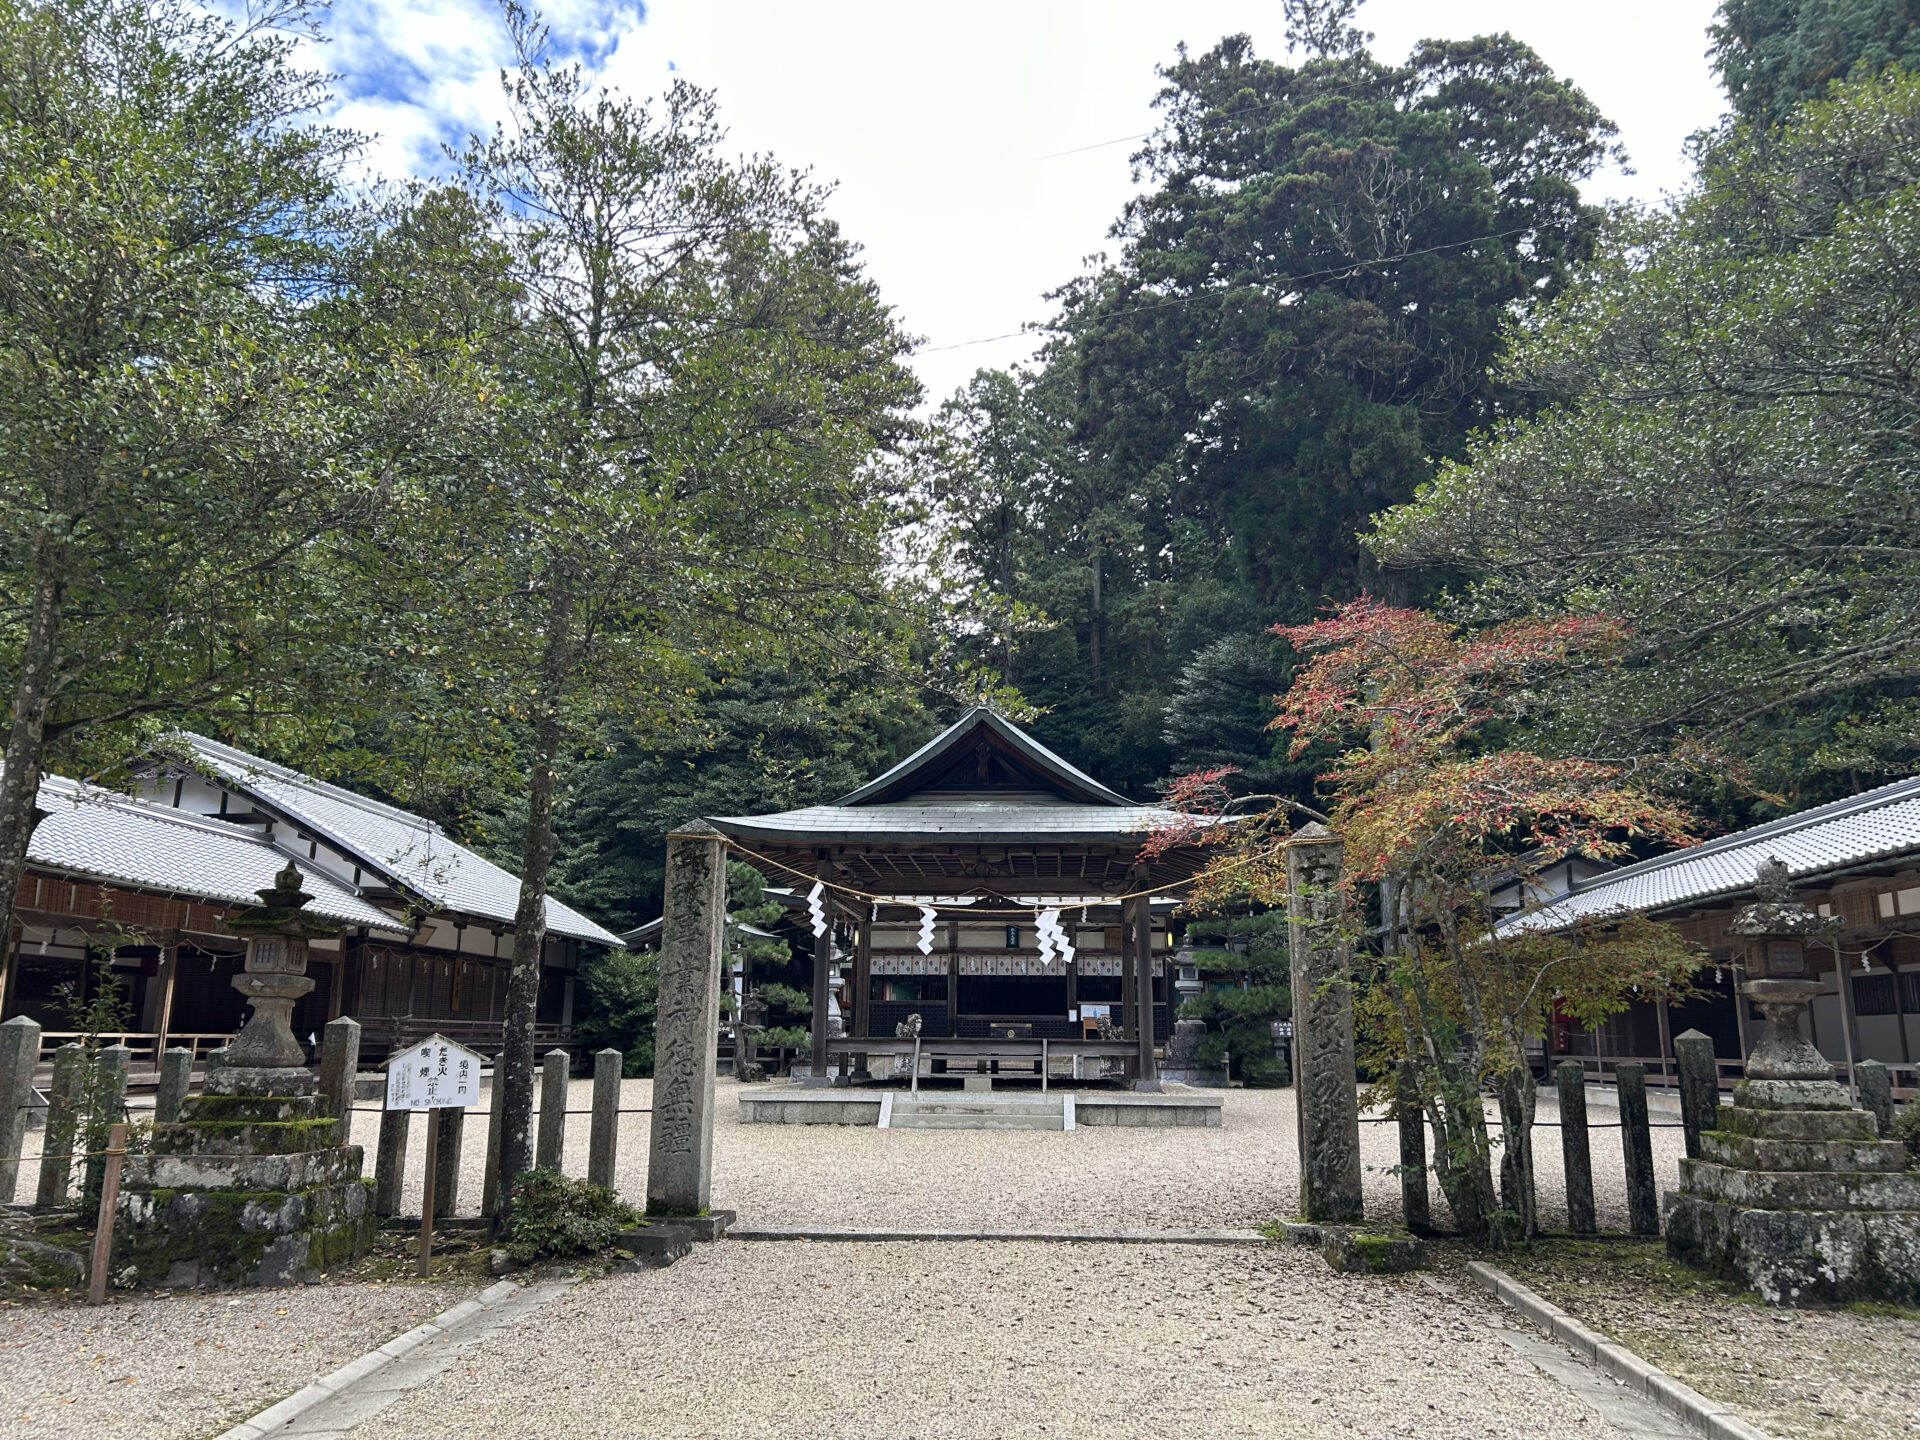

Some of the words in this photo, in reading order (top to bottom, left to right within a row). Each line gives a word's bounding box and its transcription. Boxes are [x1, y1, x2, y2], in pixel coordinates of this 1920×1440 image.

[426, 1077, 439, 1096] 禁止
[458, 1060, 469, 1095] 境内一円
[424, 1097, 453, 1106] SMOKING
